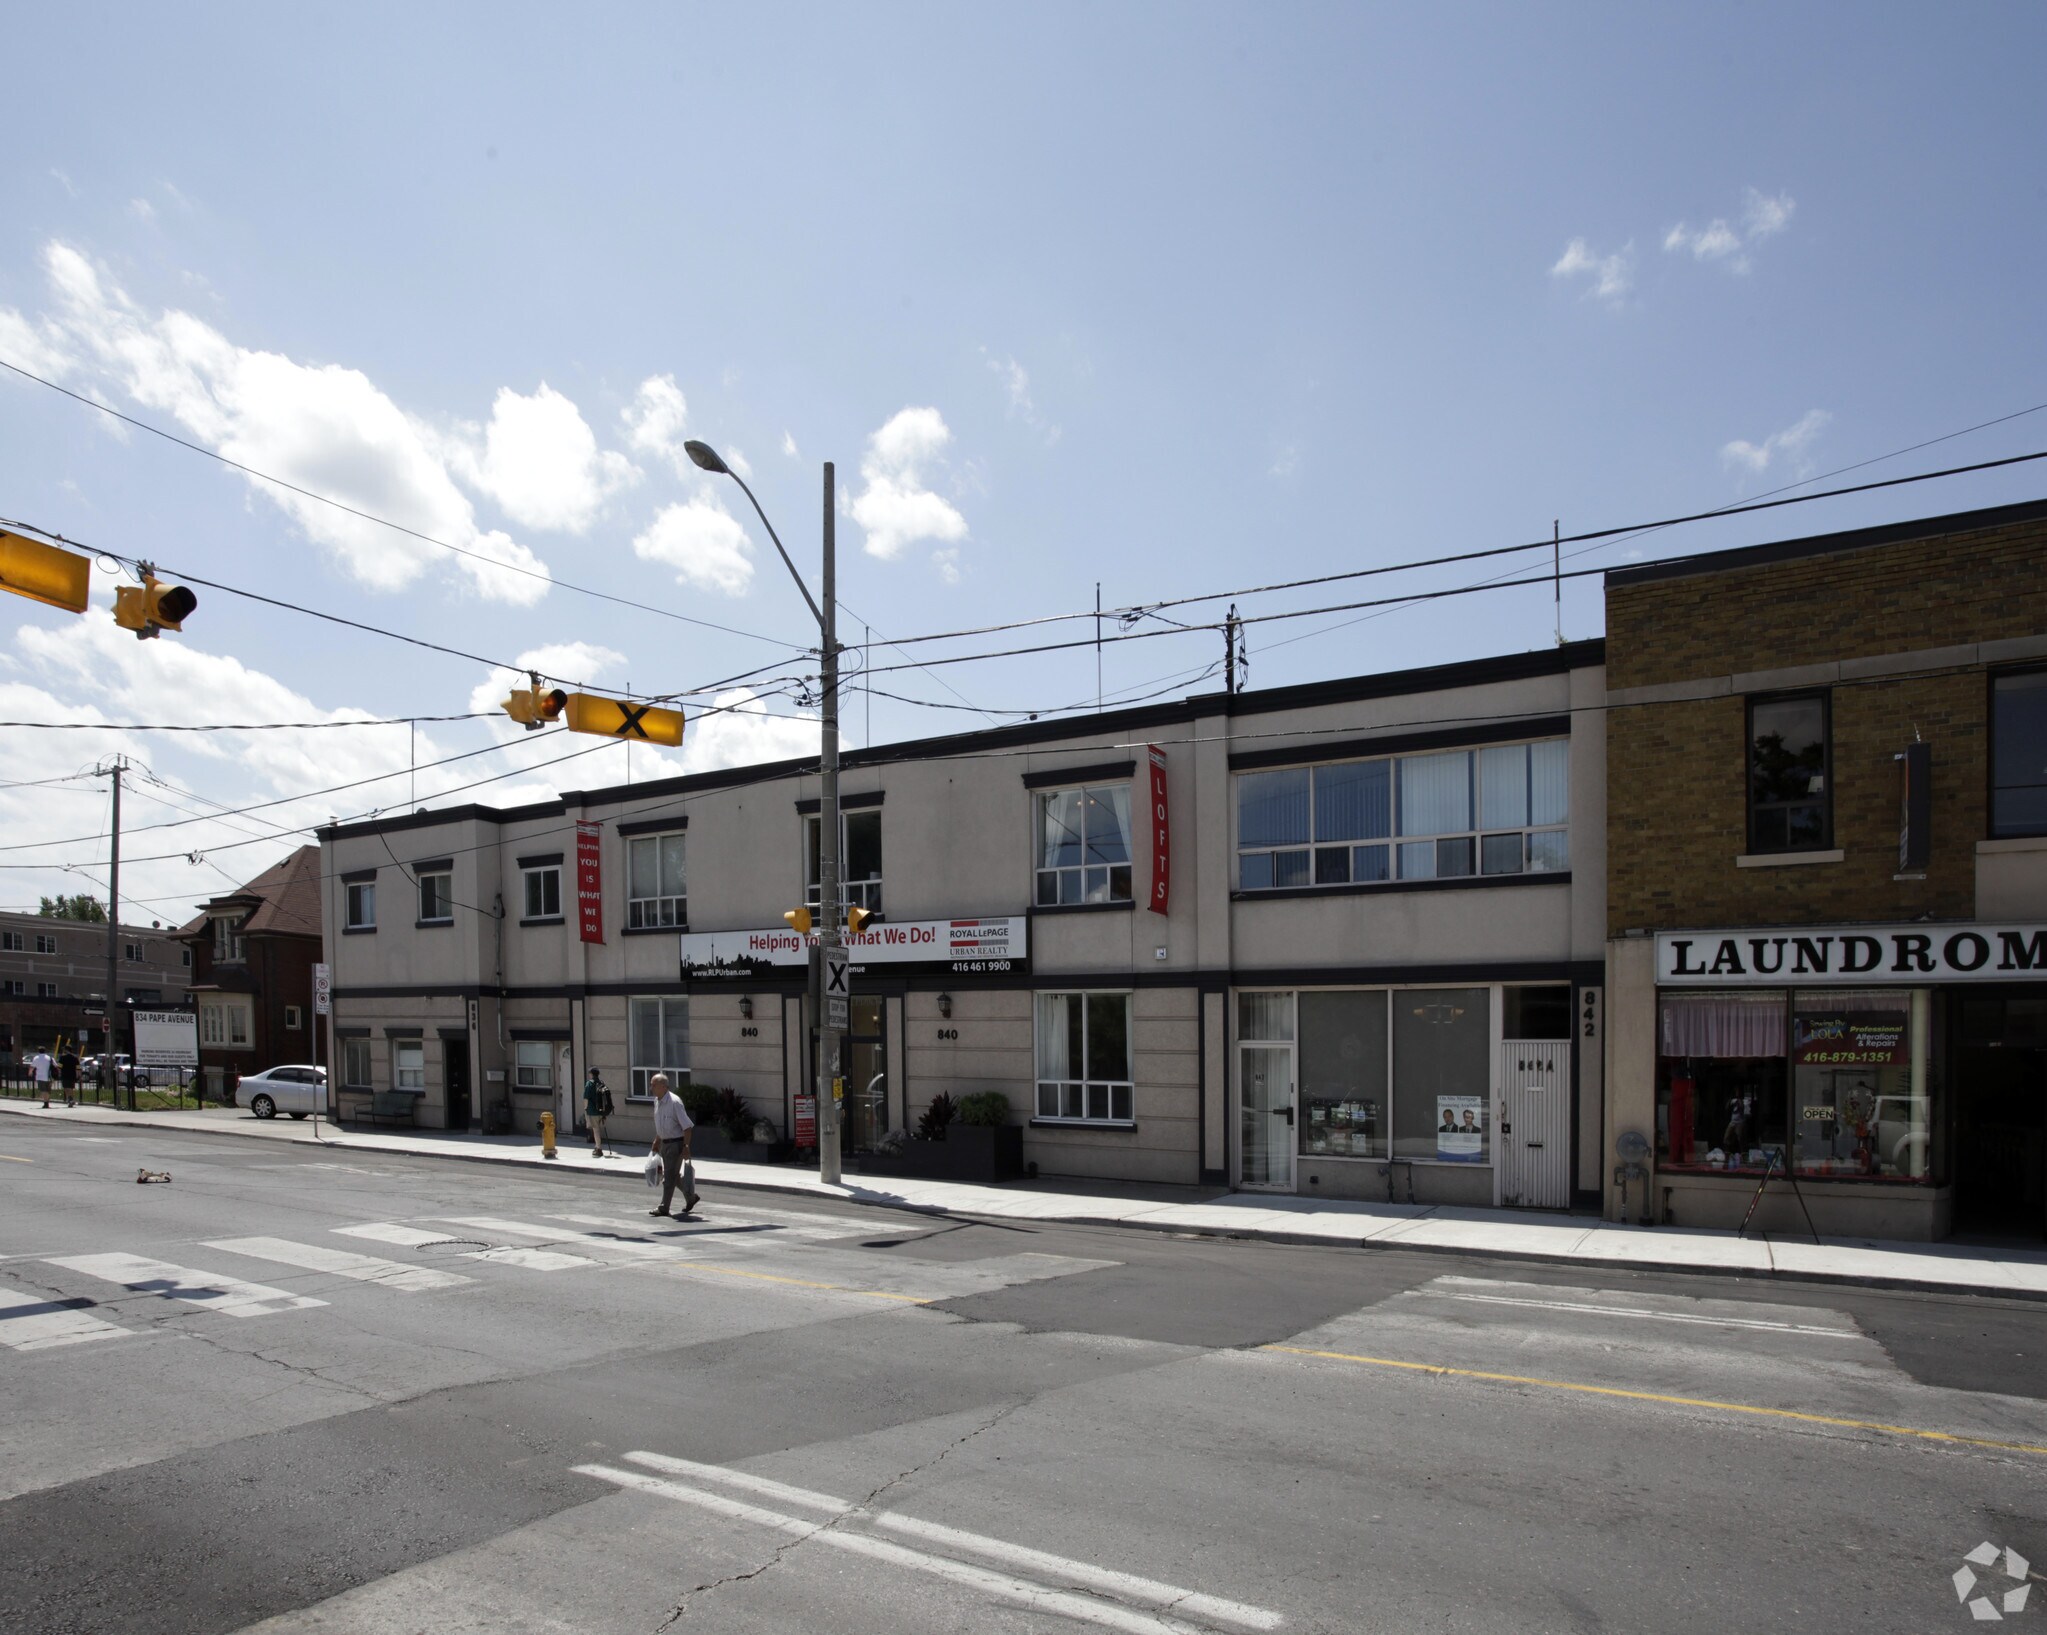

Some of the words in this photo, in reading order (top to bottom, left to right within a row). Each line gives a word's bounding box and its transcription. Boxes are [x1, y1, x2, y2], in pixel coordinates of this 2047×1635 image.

[615, 702, 650, 738] X
[1157, 777, 1167, 899] LOFTS
[580, 858, 598, 867] YOU
[586, 875, 594, 883] IS
[579, 890, 600, 900] WHAT
[584, 907, 596, 916] WE
[586, 924, 597, 932] DO
[750, 934, 799, 952] Helping
[804, 936, 820, 948] Yo
[842, 930, 880, 945] What
[884, 928, 906, 944] We
[911, 926, 936, 943] Do!
[950, 930, 977, 938] ROYAL
[950, 948, 975, 956] URBAN
[977, 946, 1009, 955] REALTY
[1670, 931, 2047, 976] LAUNDROM
[952, 962, 969, 972] 416
[970, 962, 986, 971] 461
[988, 961, 1011, 971] 9900
[692, 968, 752, 977] www.RLPUrban.com
[828, 961, 847, 992] X
[135, 1013, 147, 1021] 834
[149, 1013, 166, 1022] PAPE
[168, 1014, 194, 1023] AVENUE
[1583, 991, 1595, 1036] 842
[741, 1027, 759, 1037] 840
[1811, 1028, 1844, 1039] LOLA
[1850, 1025, 1903, 1033] Professional
[937, 1029, 958, 1040] 840
[1866, 1040, 1896, 1048] Repairs
[1804, 1052, 1892, 1062] 416-879-1351
[1804, 1110, 1833, 1119] OPEN
